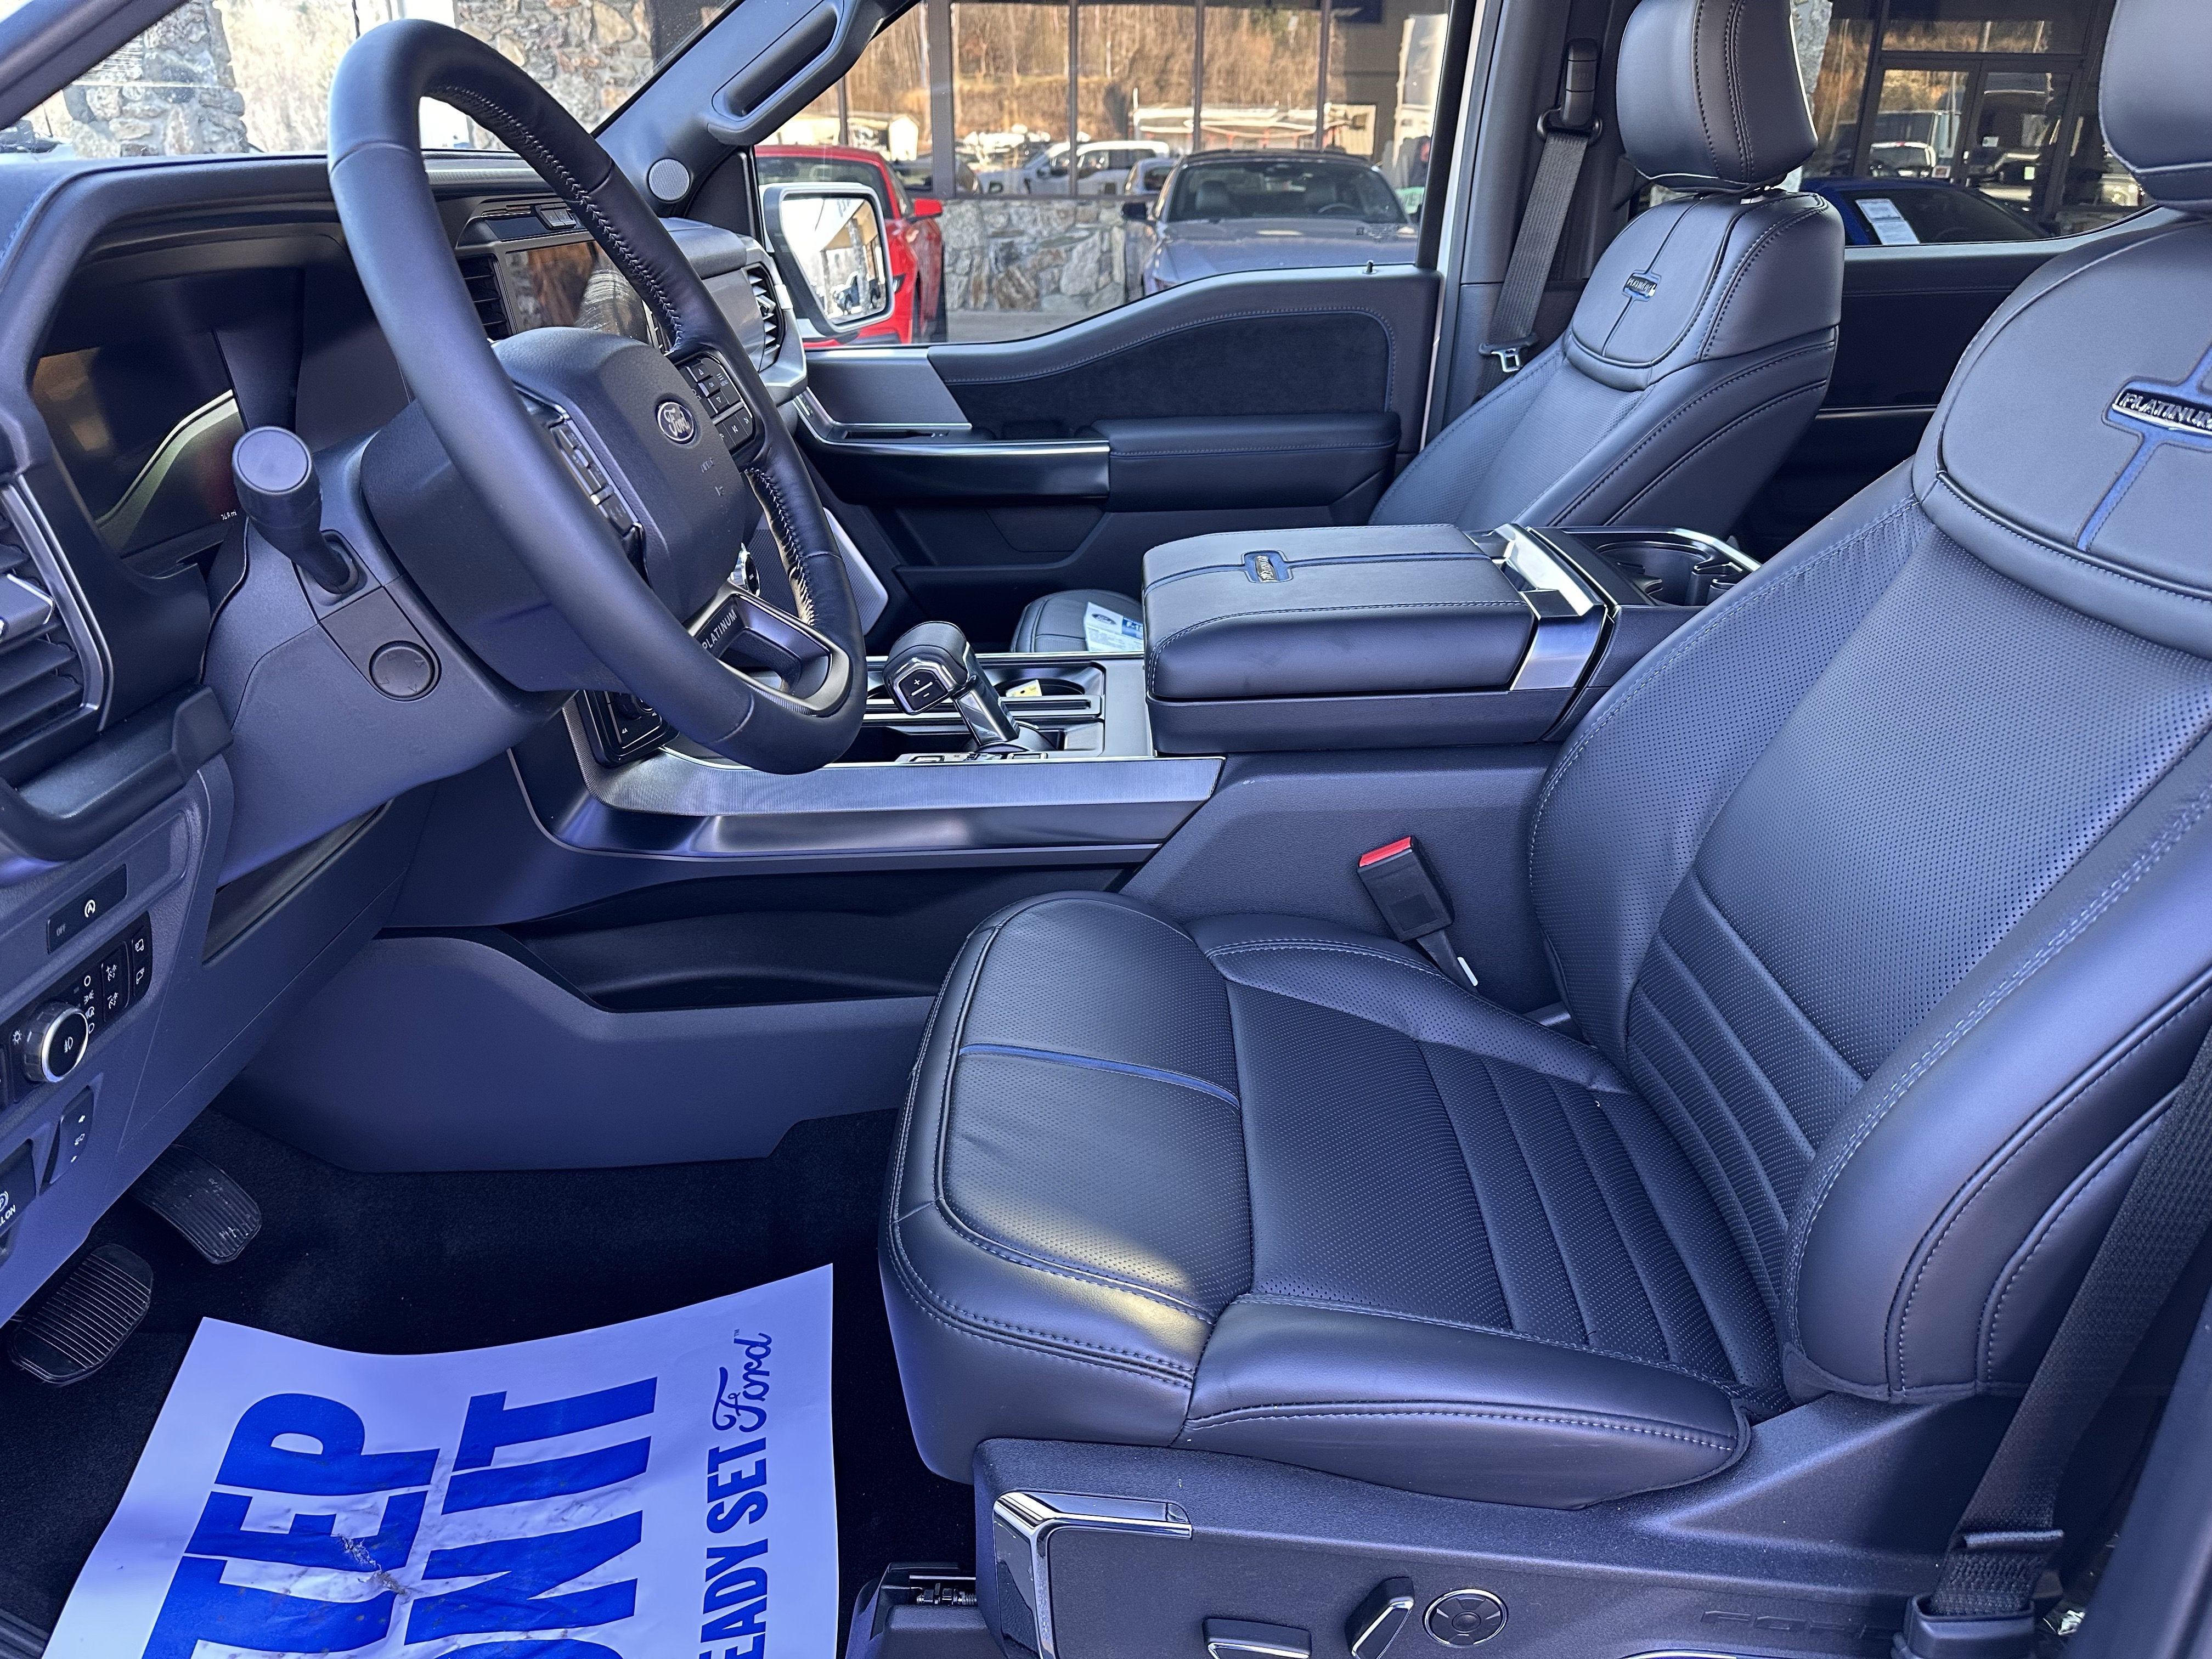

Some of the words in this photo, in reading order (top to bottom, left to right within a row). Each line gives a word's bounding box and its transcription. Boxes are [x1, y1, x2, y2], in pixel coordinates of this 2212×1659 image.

[663, 407, 691, 438] Ford
[702, 608, 737, 650] PLATINUM
[5, 1204, 16, 1220] ON
[712, 1332, 772, 1433] Ford
[706, 1437, 769, 1534] SET
[403, 1510, 643, 1659] N
